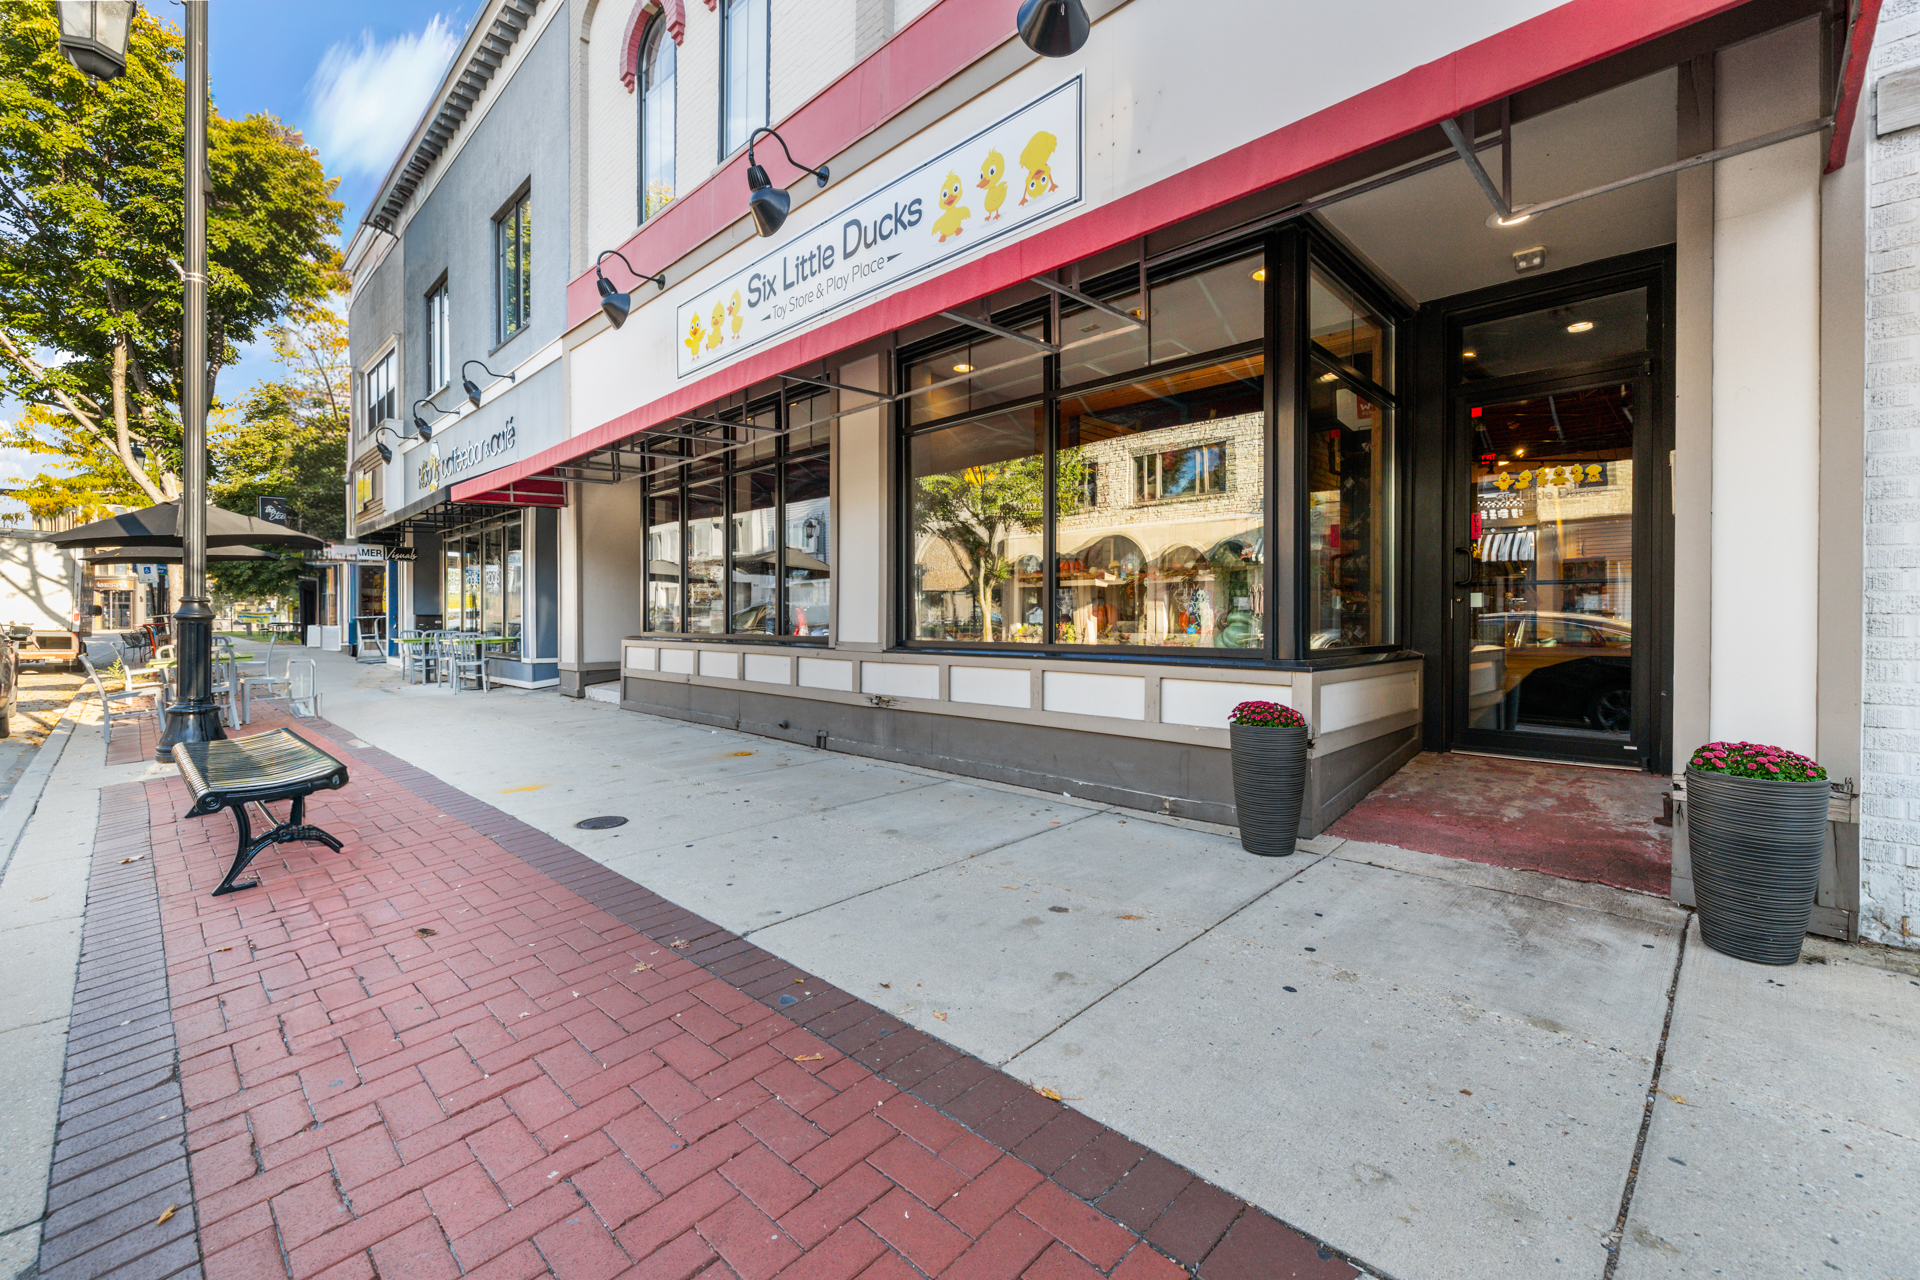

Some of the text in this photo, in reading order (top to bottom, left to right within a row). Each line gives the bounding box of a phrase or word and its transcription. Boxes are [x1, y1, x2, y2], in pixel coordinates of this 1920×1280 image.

[747, 198, 922, 308] Six Little Ducks
[772, 257, 885, 320] Toy Store & Play Place
[385, 546, 418, 560] Visuals
